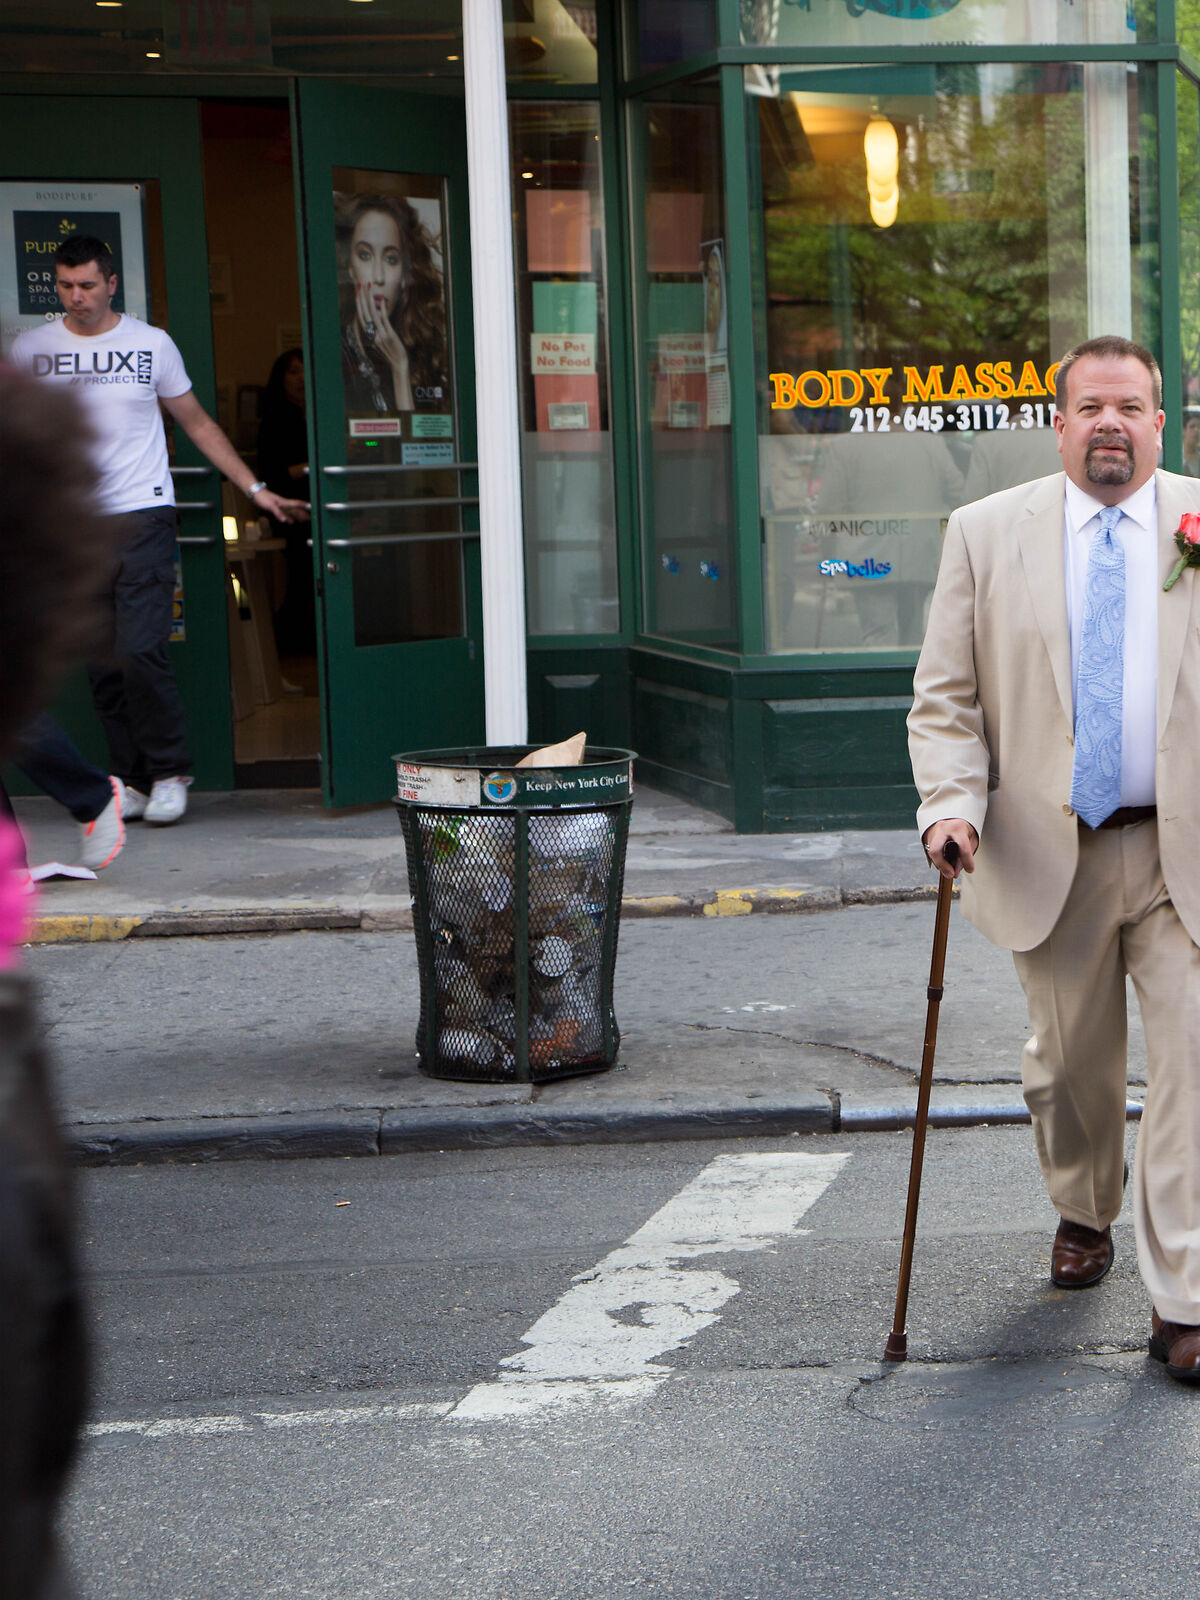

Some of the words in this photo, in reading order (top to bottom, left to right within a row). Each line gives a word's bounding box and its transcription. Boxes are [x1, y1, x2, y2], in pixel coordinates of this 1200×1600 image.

[541, 340, 560, 352] No
[564, 340, 586, 352] Pet
[537, 356, 556, 367] No
[559, 356, 591, 367] Food
[84, 376, 138, 385] PROJECT
[769, 367, 893, 409] BODY
[902, 359, 1061, 403] MASSA
[403, 763, 422, 776] ONLY
[526, 781, 552, 793] Keep
[555, 780, 576, 790] New
[578, 777, 599, 789] York
[600, 776, 614, 788] City
[403, 789, 419, 800] FINE
